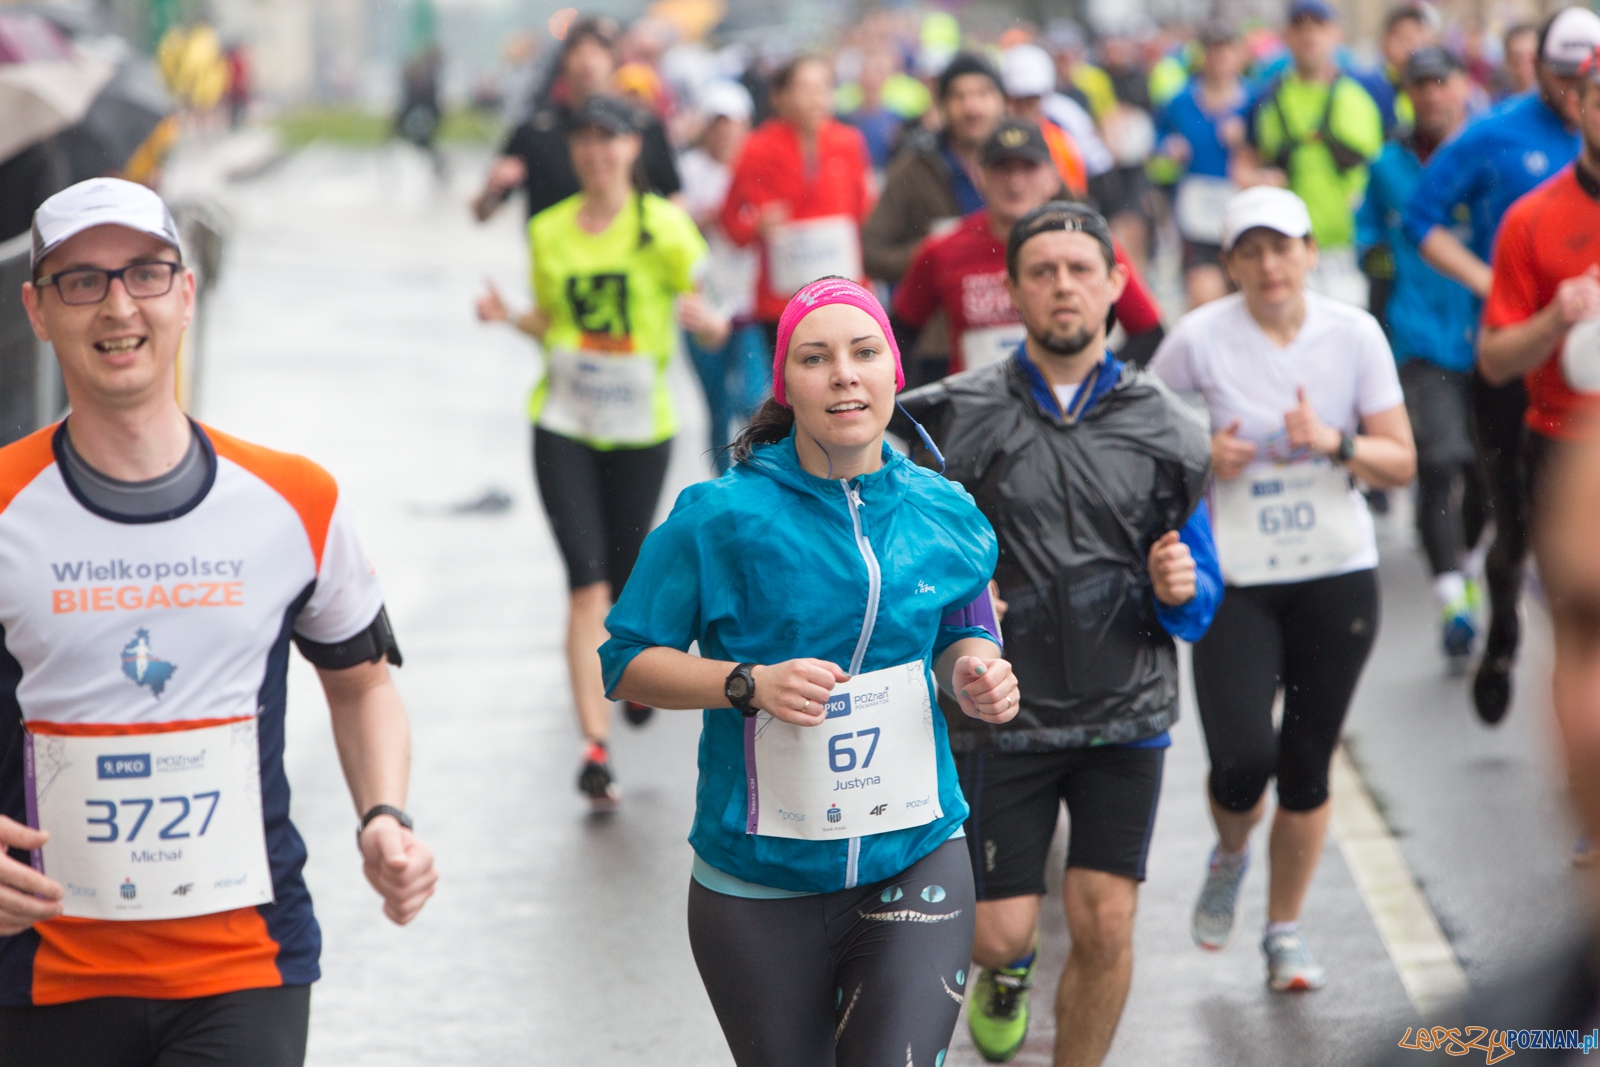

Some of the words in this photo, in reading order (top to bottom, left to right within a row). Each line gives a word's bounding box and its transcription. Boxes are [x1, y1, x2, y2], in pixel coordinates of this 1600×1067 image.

[1258, 501, 1316, 535] 610
[51, 557, 244, 582] Wielkopolscy
[52, 582, 244, 614] BIEGACZE
[828, 727, 881, 773] 67
[833, 775, 881, 791] Justyna
[86, 790, 220, 843] 3727
